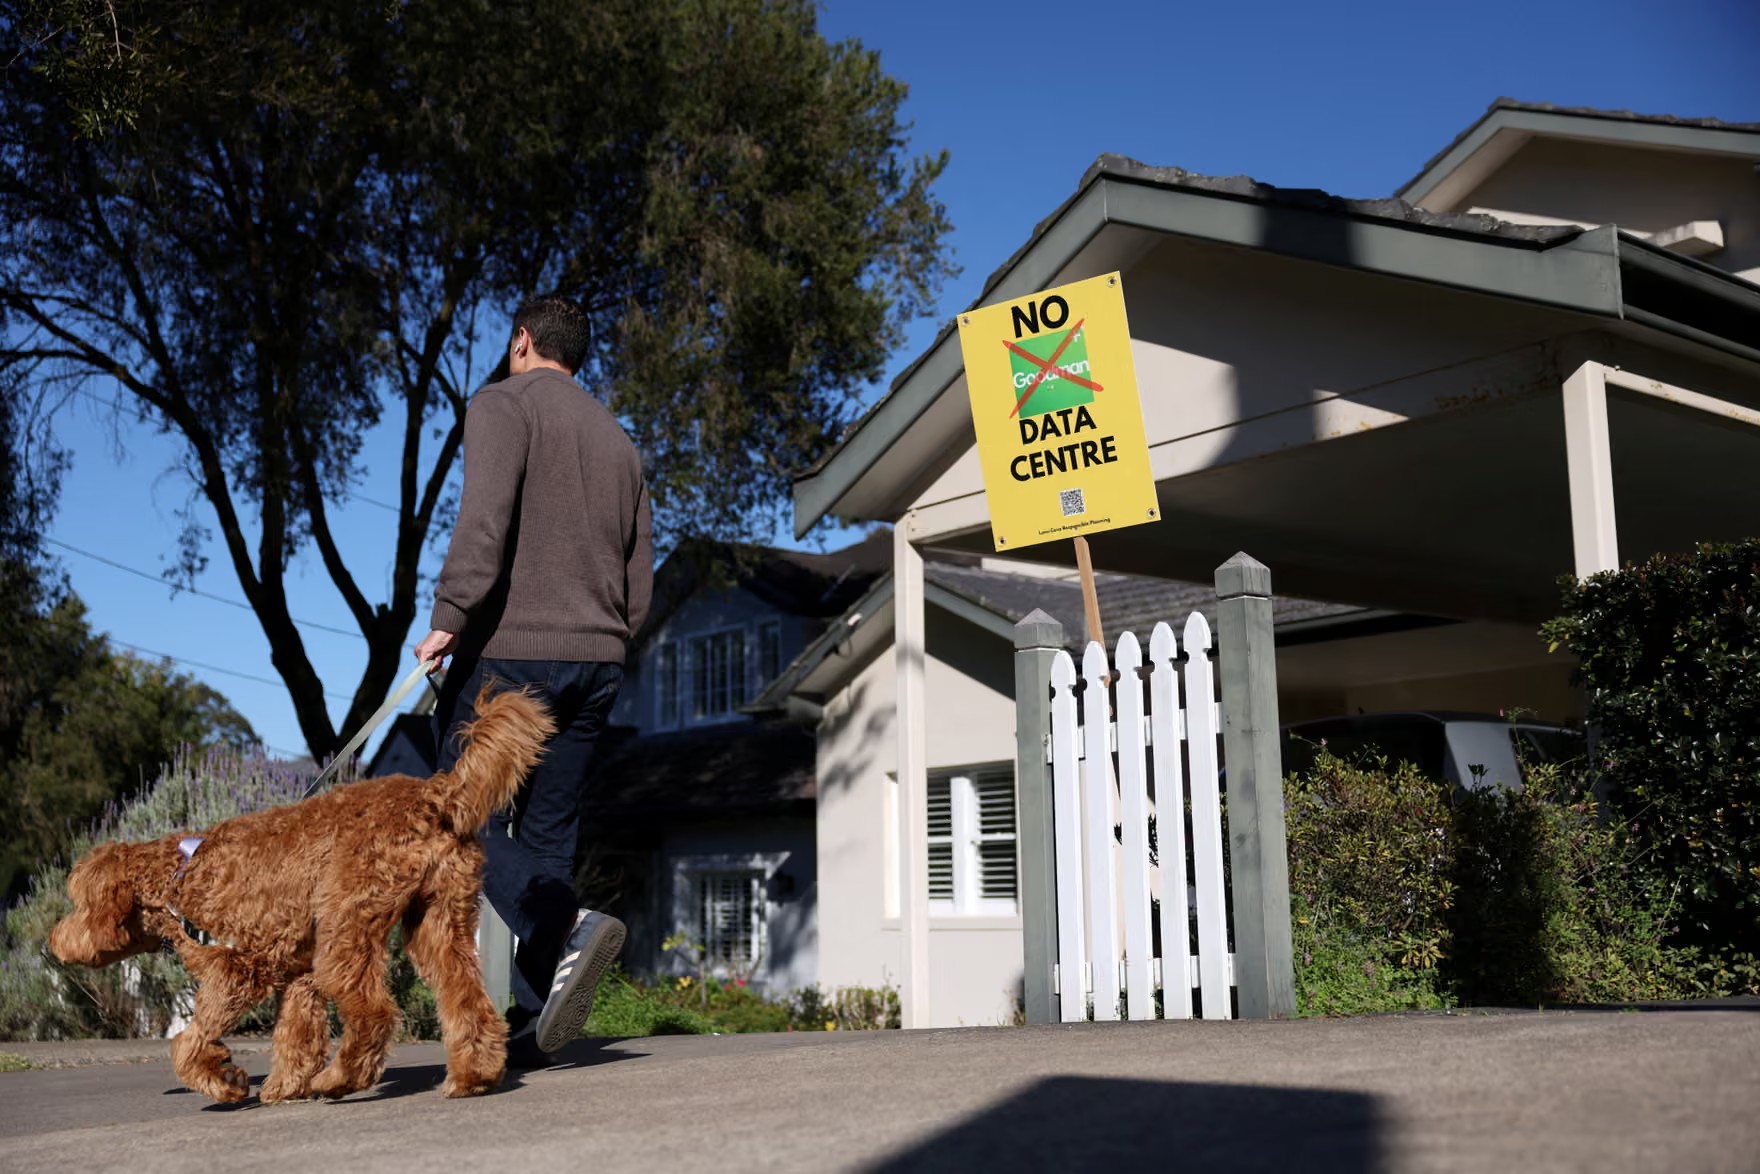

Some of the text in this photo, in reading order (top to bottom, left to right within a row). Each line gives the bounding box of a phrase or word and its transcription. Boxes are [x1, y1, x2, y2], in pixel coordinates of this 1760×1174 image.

[1011, 295, 1070, 338] NO
[1013, 360, 1090, 389] Goodman
[1019, 405, 1097, 445] DATA
[1010, 435, 1118, 482] CENTRE
